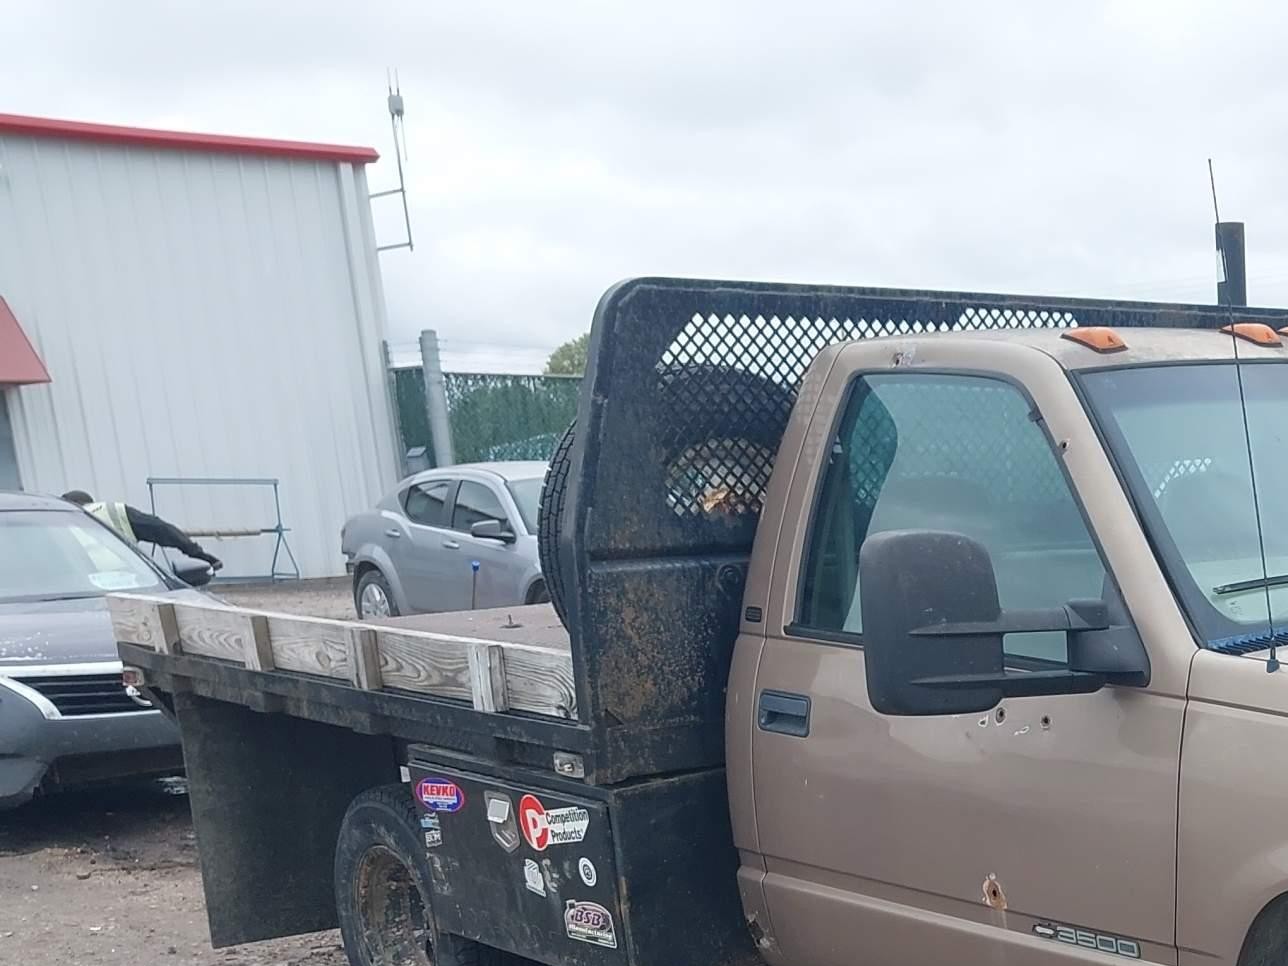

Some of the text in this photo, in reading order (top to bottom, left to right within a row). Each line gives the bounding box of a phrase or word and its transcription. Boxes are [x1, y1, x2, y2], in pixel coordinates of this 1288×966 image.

[423, 784, 455, 797] KEVKO
[545, 808, 588, 826] Competition
[551, 827, 582, 842] Products
